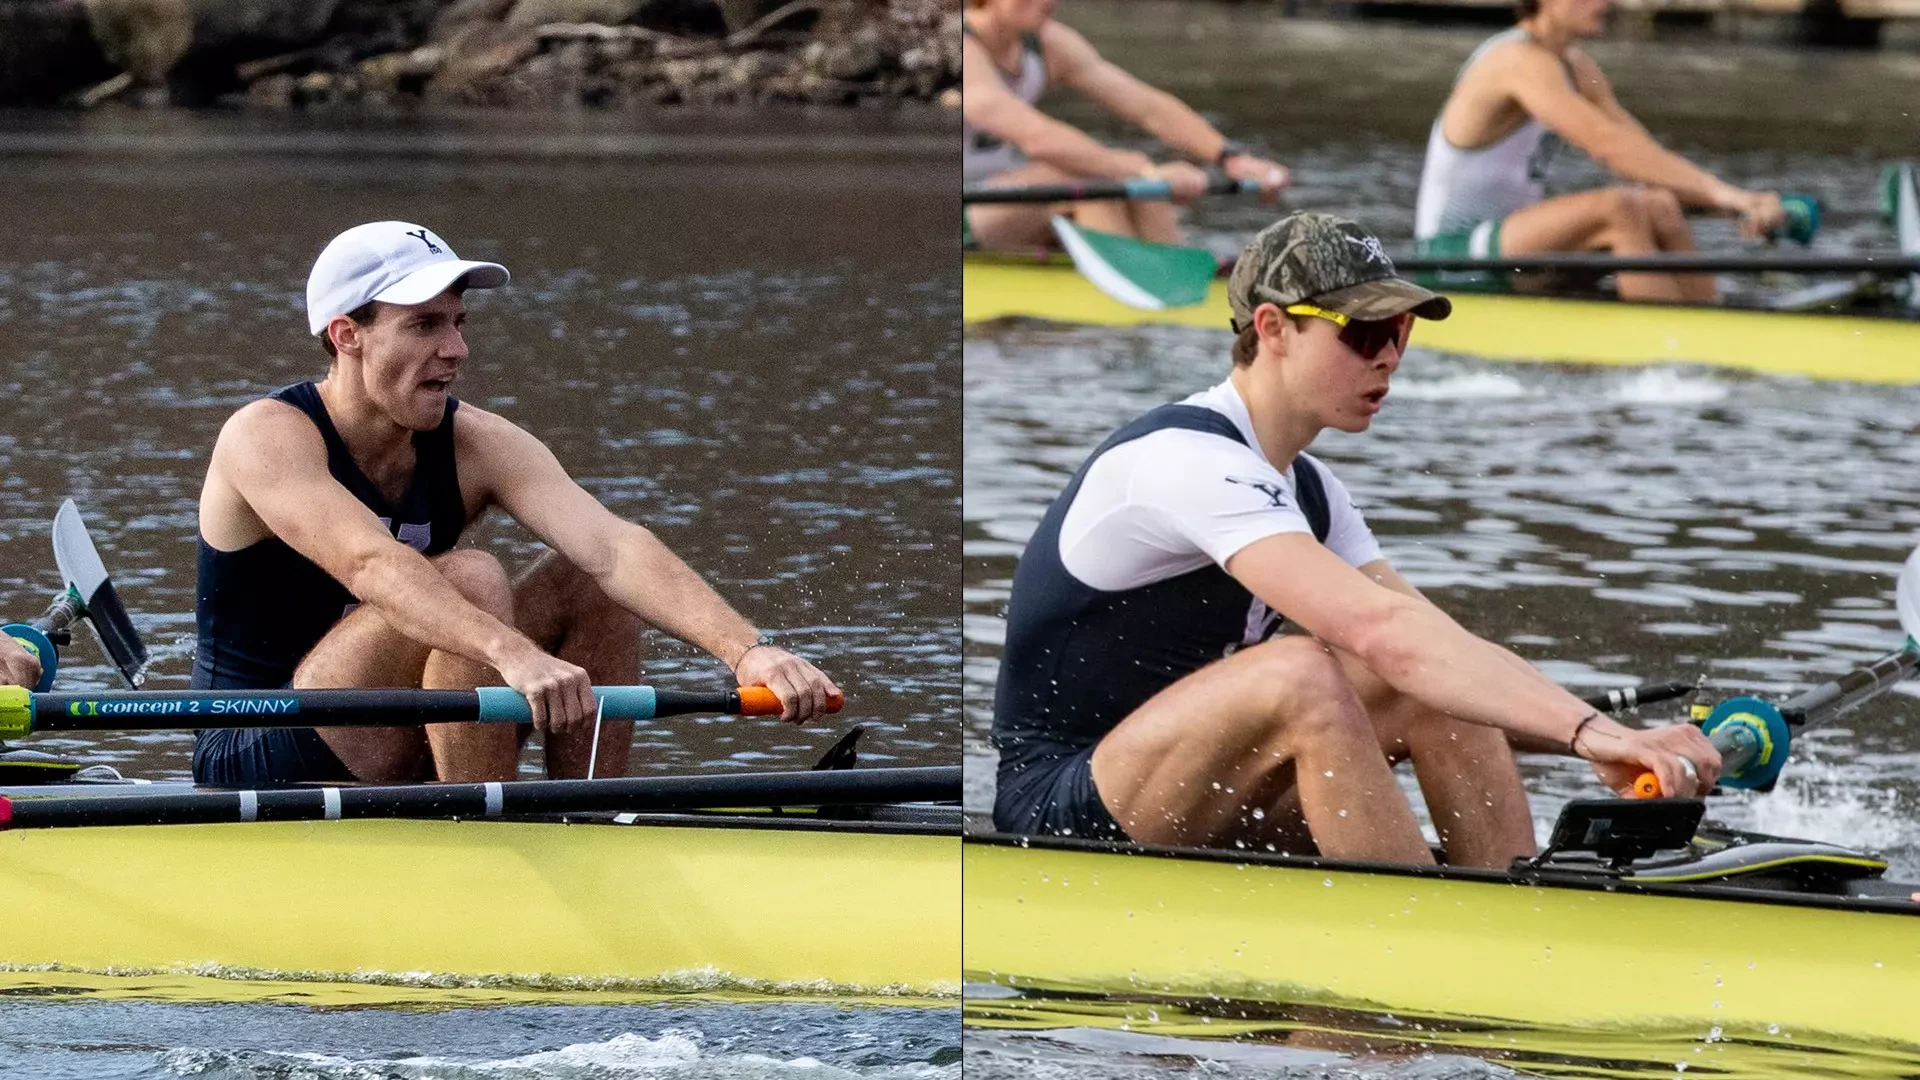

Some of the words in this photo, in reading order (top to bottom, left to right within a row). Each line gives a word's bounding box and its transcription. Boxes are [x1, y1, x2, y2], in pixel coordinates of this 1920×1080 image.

[406, 230, 436, 248] Y
[1253, 484, 1288, 507] Y
[101, 702, 184, 714] concept
[189, 701, 200, 713] 2
[210, 700, 294, 714] SKINNY
